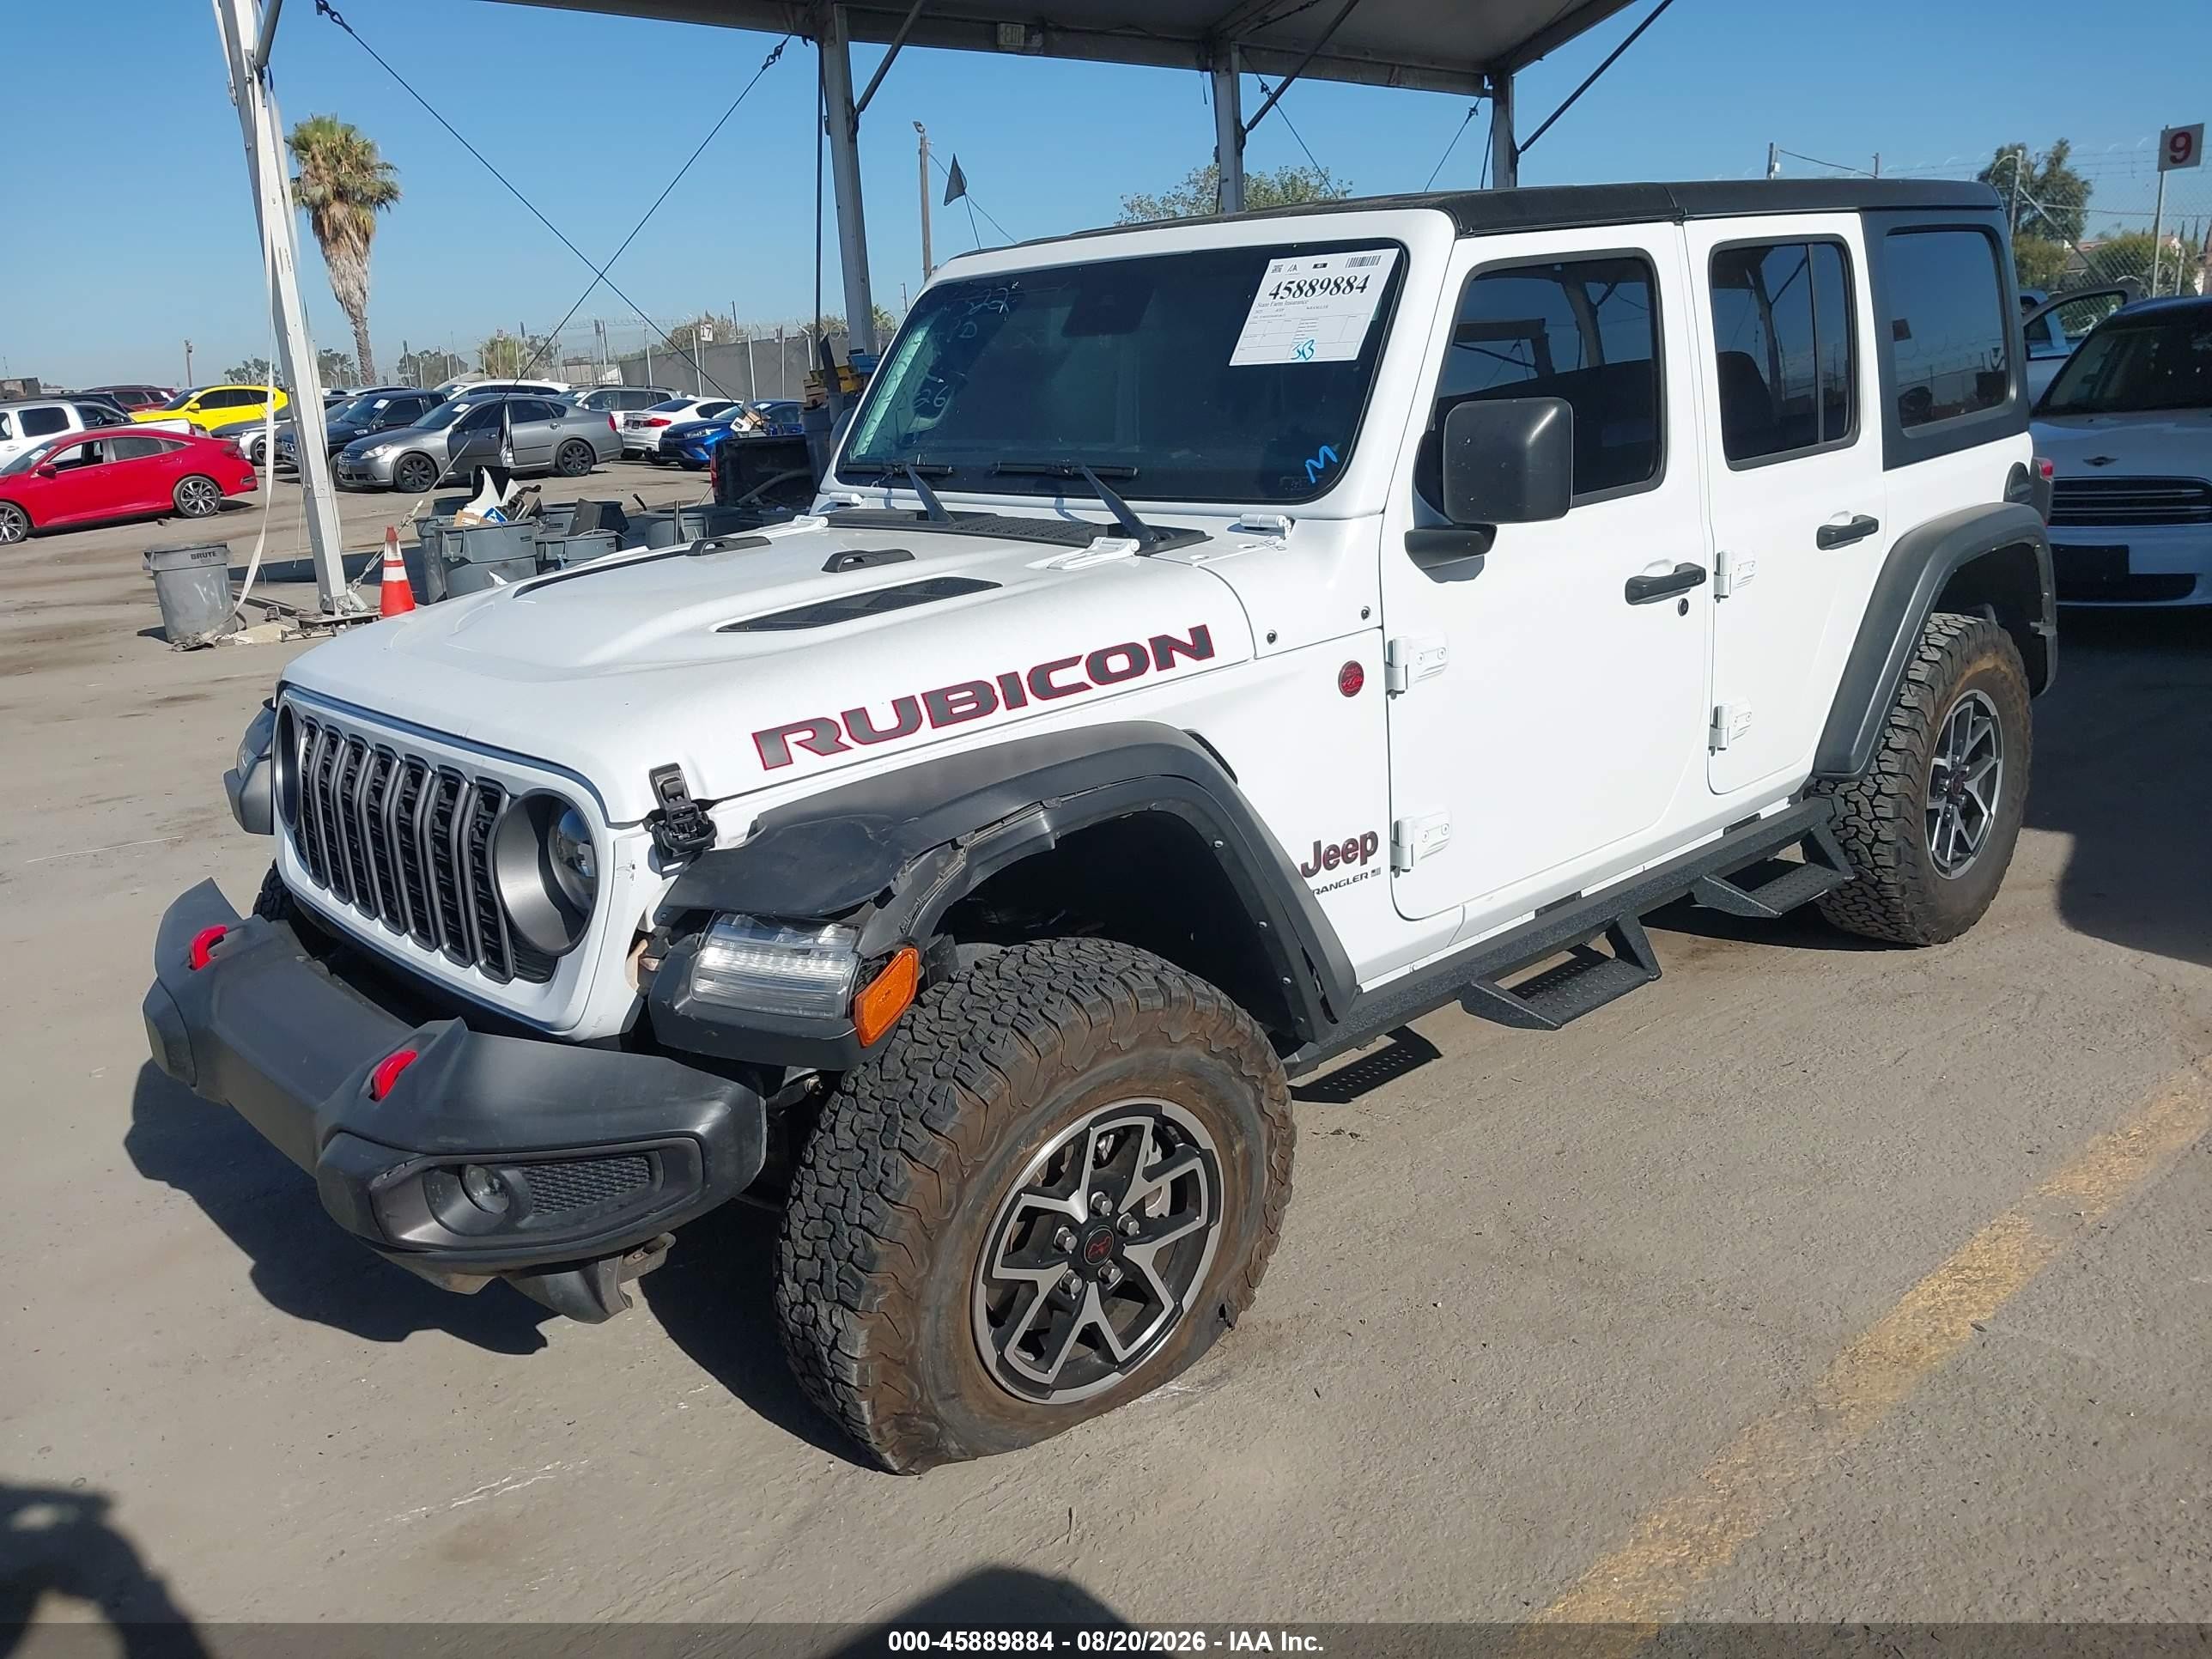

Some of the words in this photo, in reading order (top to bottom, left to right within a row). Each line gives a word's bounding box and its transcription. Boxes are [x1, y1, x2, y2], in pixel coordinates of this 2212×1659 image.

[2169, 131, 2192, 164] 9
[1268, 274, 1371, 300] 45889884
[701, 326, 712, 338] 17
[191, 550, 217, 560] BRUTE
[751, 623, 1216, 771] RUBICON
[1300, 830, 1379, 878] Jeep
[1312, 872, 1369, 895] RANGLER
